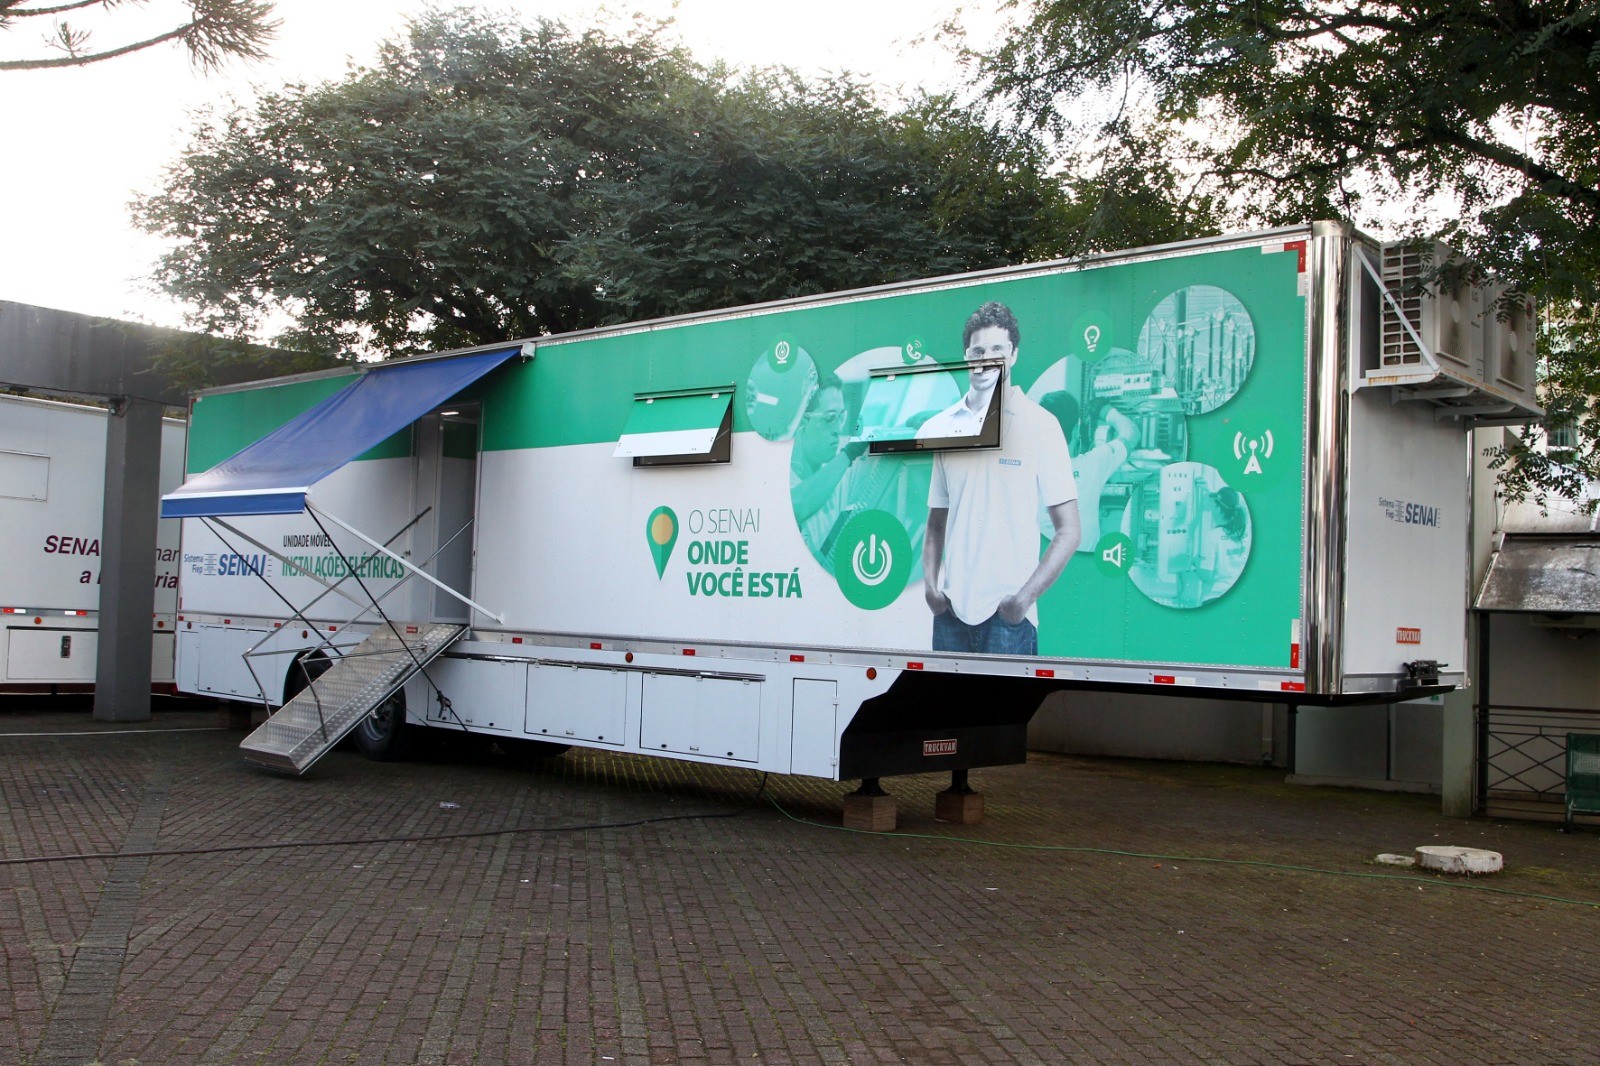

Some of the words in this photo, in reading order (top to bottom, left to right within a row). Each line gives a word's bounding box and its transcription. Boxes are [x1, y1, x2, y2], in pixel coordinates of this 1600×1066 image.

[688, 509, 704, 534] O
[707, 508, 760, 534] SENAI
[1404, 502, 1438, 527] SENAI
[44, 535, 100, 556] SENA
[283, 534, 309, 548] UNIDADE
[310, 532, 331, 547] MÓVEL
[184, 553, 204, 563] Sistema
[687, 540, 749, 565] ONDE
[79, 570, 92, 584] a
[217, 553, 267, 577] SENAI
[282, 551, 346, 581] INSTALAÇÕES
[349, 551, 405, 579] ELÉTRICAS
[686, 567, 744, 597] VOCÊ
[748, 567, 803, 598] ESTÁ
